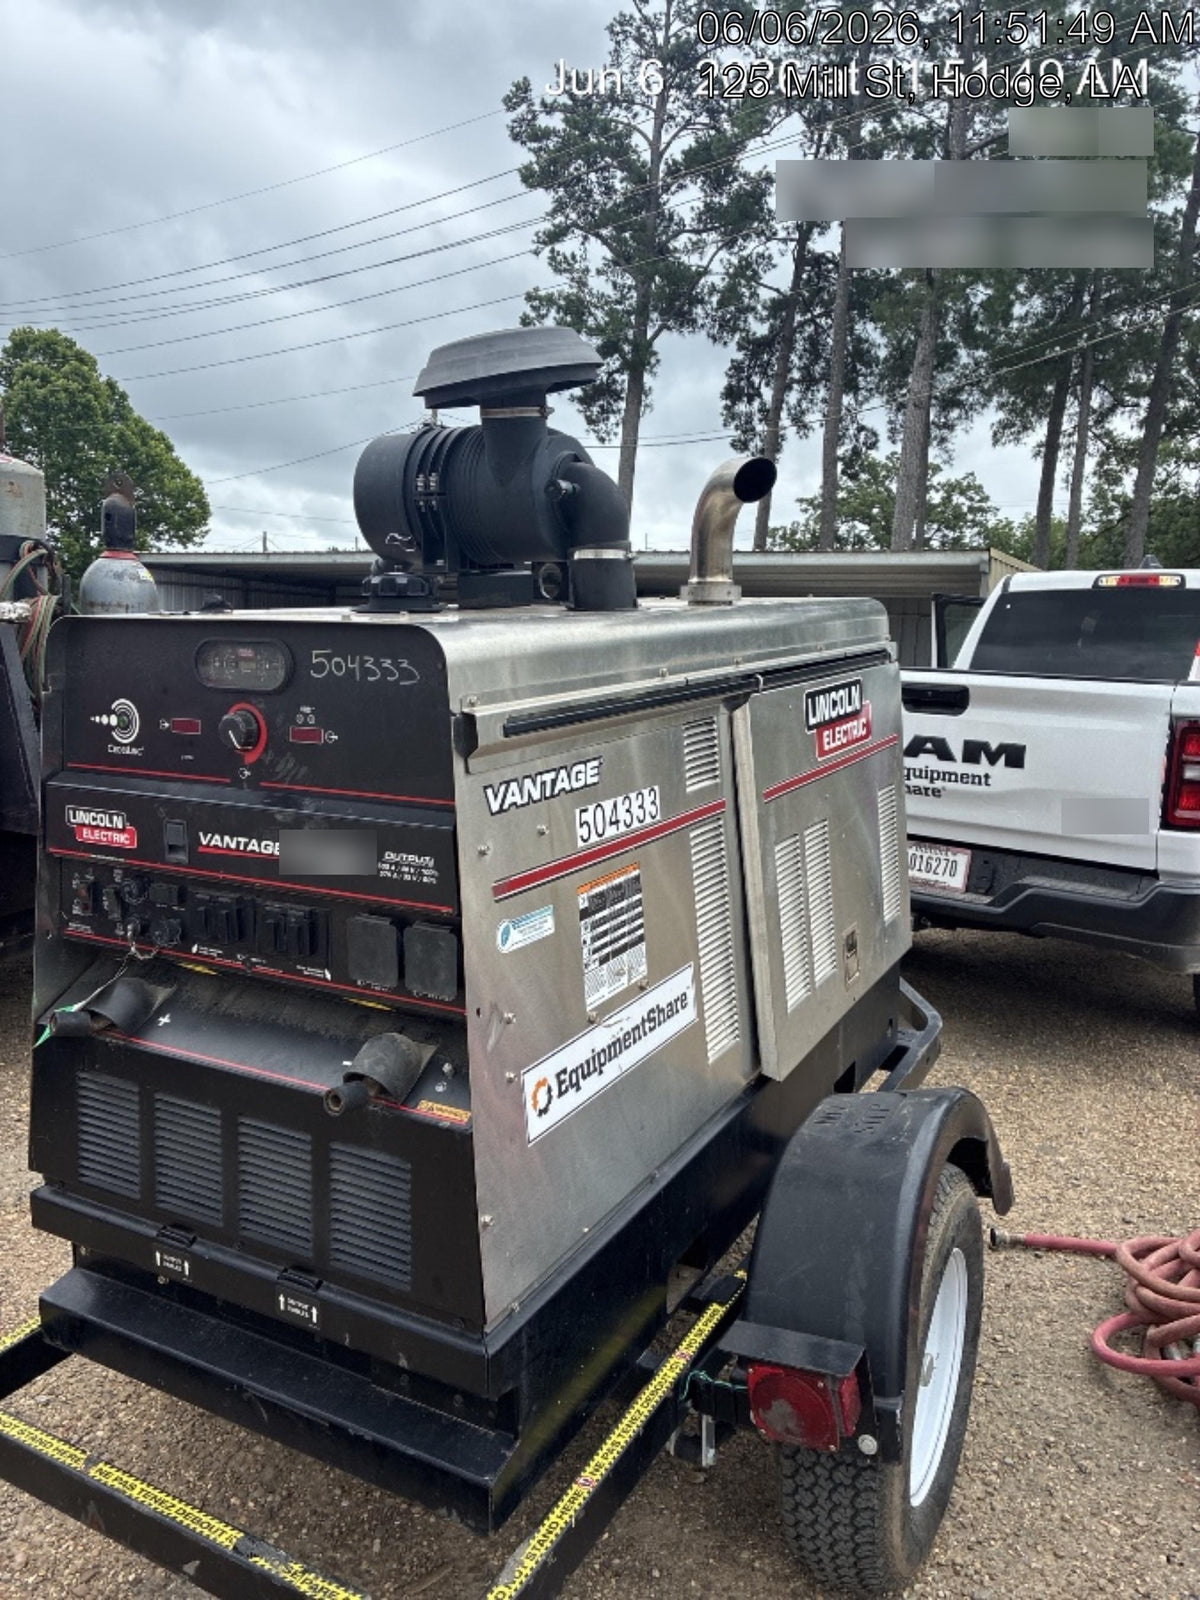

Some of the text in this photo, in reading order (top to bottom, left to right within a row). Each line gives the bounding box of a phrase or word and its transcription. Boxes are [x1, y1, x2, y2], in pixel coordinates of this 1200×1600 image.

[310, 650, 420, 685] 504333
[808, 684, 860, 726] LINCOLN
[823, 718, 867, 751] ELECTRIC
[903, 734, 1027, 769] AM
[484, 759, 602, 815] VANTAGE
[904, 766, 992, 787] quipment
[69, 809, 124, 829] LINCOLN
[579, 787, 659, 843] 504333
[81, 828, 132, 844] ELECTRIC
[556, 990, 688, 1100] EquipmentShare
[112, 1474, 137, 1492] PAS
[136, 1487, 176, 1512] TENEZ
[174, 1506, 227, 1539] DEBOUT
[523, 1518, 561, 1562] STAND
[555, 1487, 584, 1520] HERE
